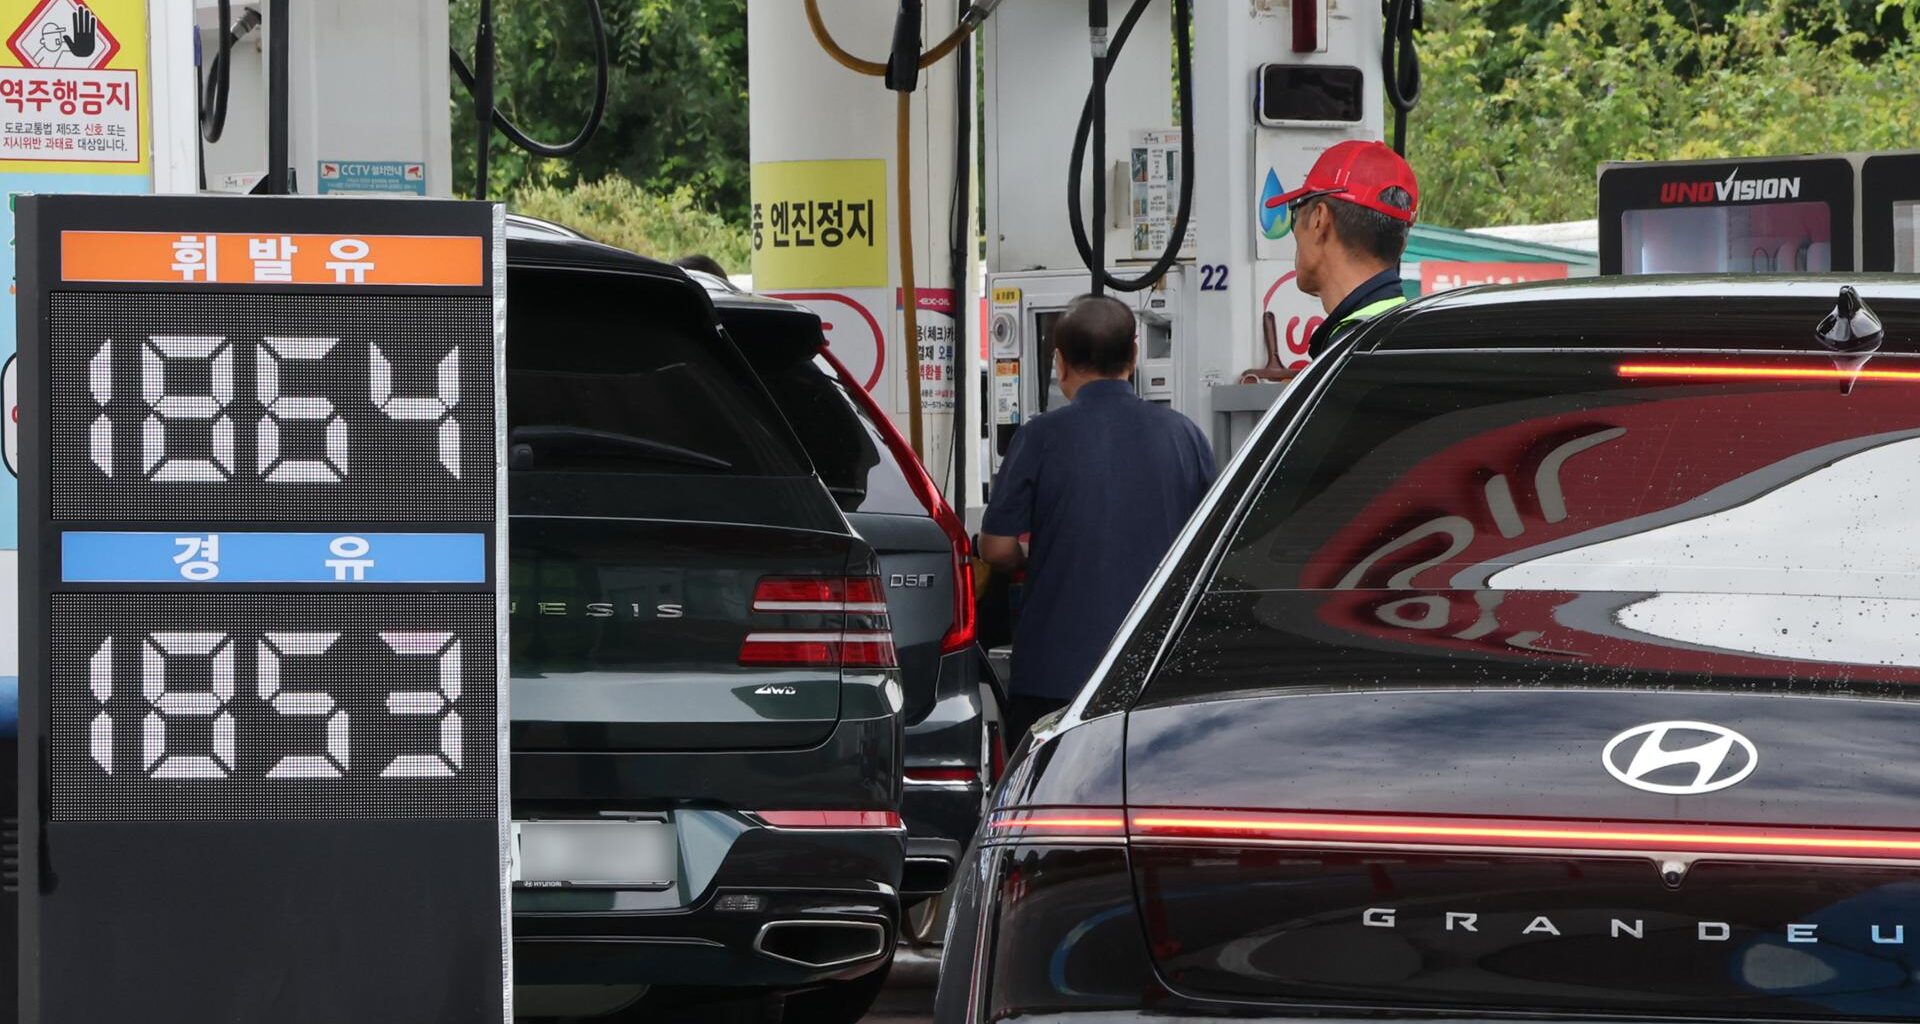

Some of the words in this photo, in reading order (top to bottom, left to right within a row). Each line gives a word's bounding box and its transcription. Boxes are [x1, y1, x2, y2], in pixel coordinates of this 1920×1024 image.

[0, 79, 130, 115] 역주행금지
[3, 137, 41, 150] 지시위반
[45, 138, 74, 152] 과태료
[78, 138, 128, 152] 대상입니다.
[4, 122, 52, 135] 도로교통법
[56, 123, 80, 135] 제5조
[84, 123, 104, 136] 신호
[107, 124, 126, 137] 또는
[341, 164, 370, 176] CCTV
[1660, 166, 1801, 204] UNOVISION
[771, 199, 874, 248] 엔진정지
[1200, 264, 1229, 291] 22
[90, 335, 461, 483] 1864
[90, 632, 463, 779] 1853
[754, 684, 797, 695] 4WD
[1362, 907, 1905, 945] GRANDEU
